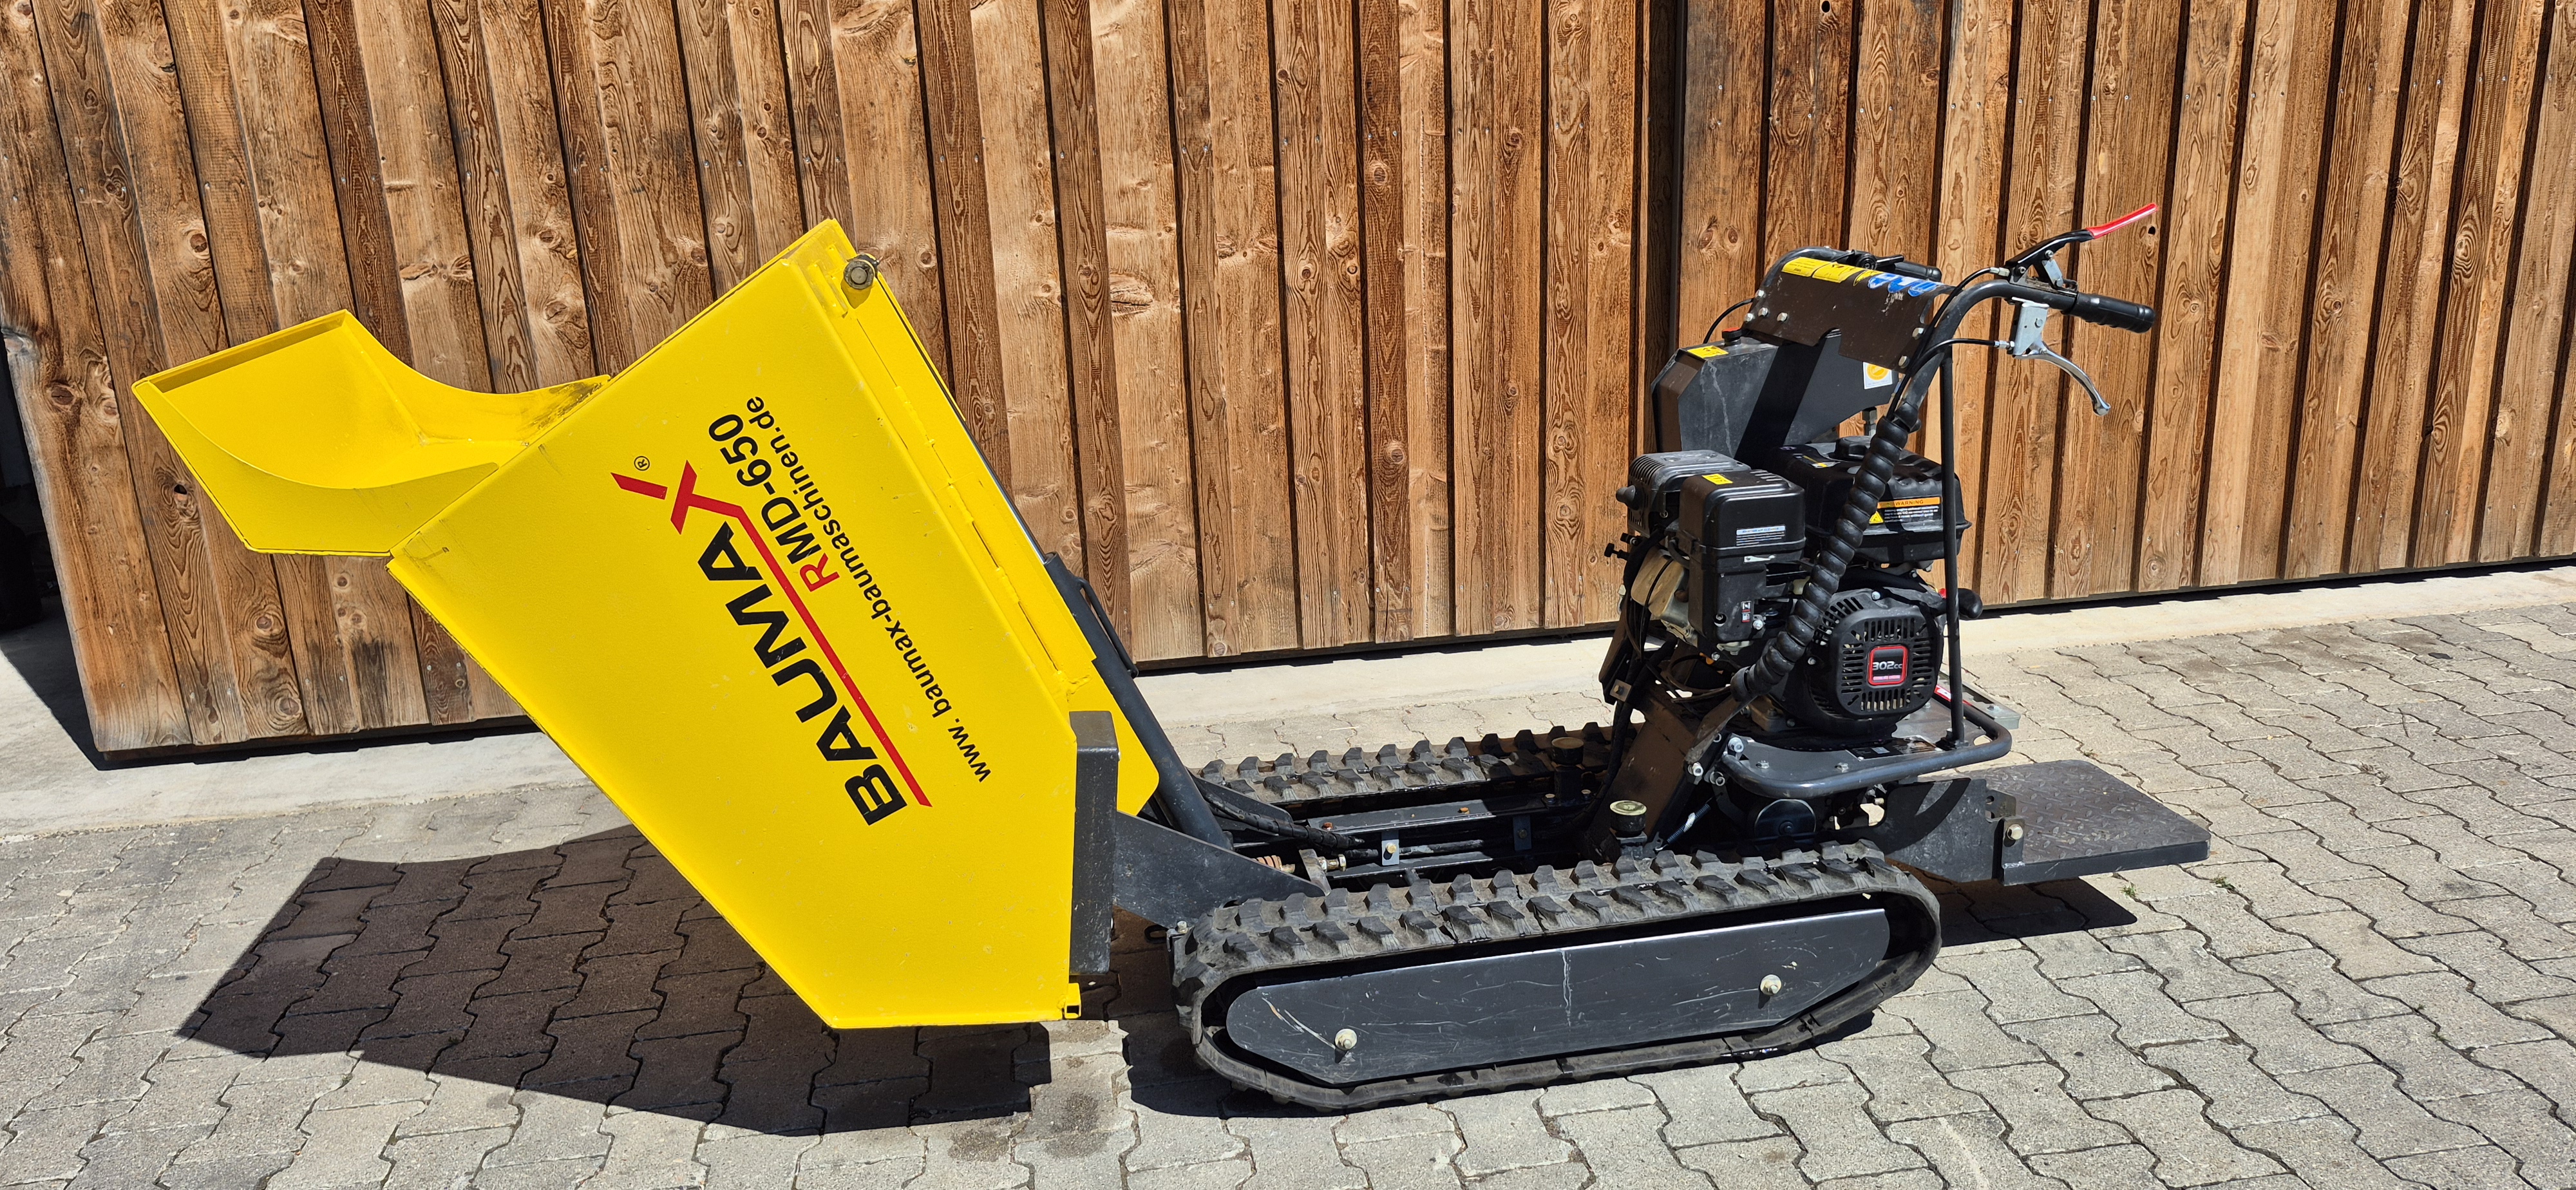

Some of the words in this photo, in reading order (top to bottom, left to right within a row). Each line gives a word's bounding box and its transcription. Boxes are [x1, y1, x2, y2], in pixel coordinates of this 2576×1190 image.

[708, 413, 840, 592] RMD-650
[746, 395, 952, 718] baumax-baumaschinen.de
[1872, 661, 1902, 670] 302cc
[947, 718, 990, 782] www.
